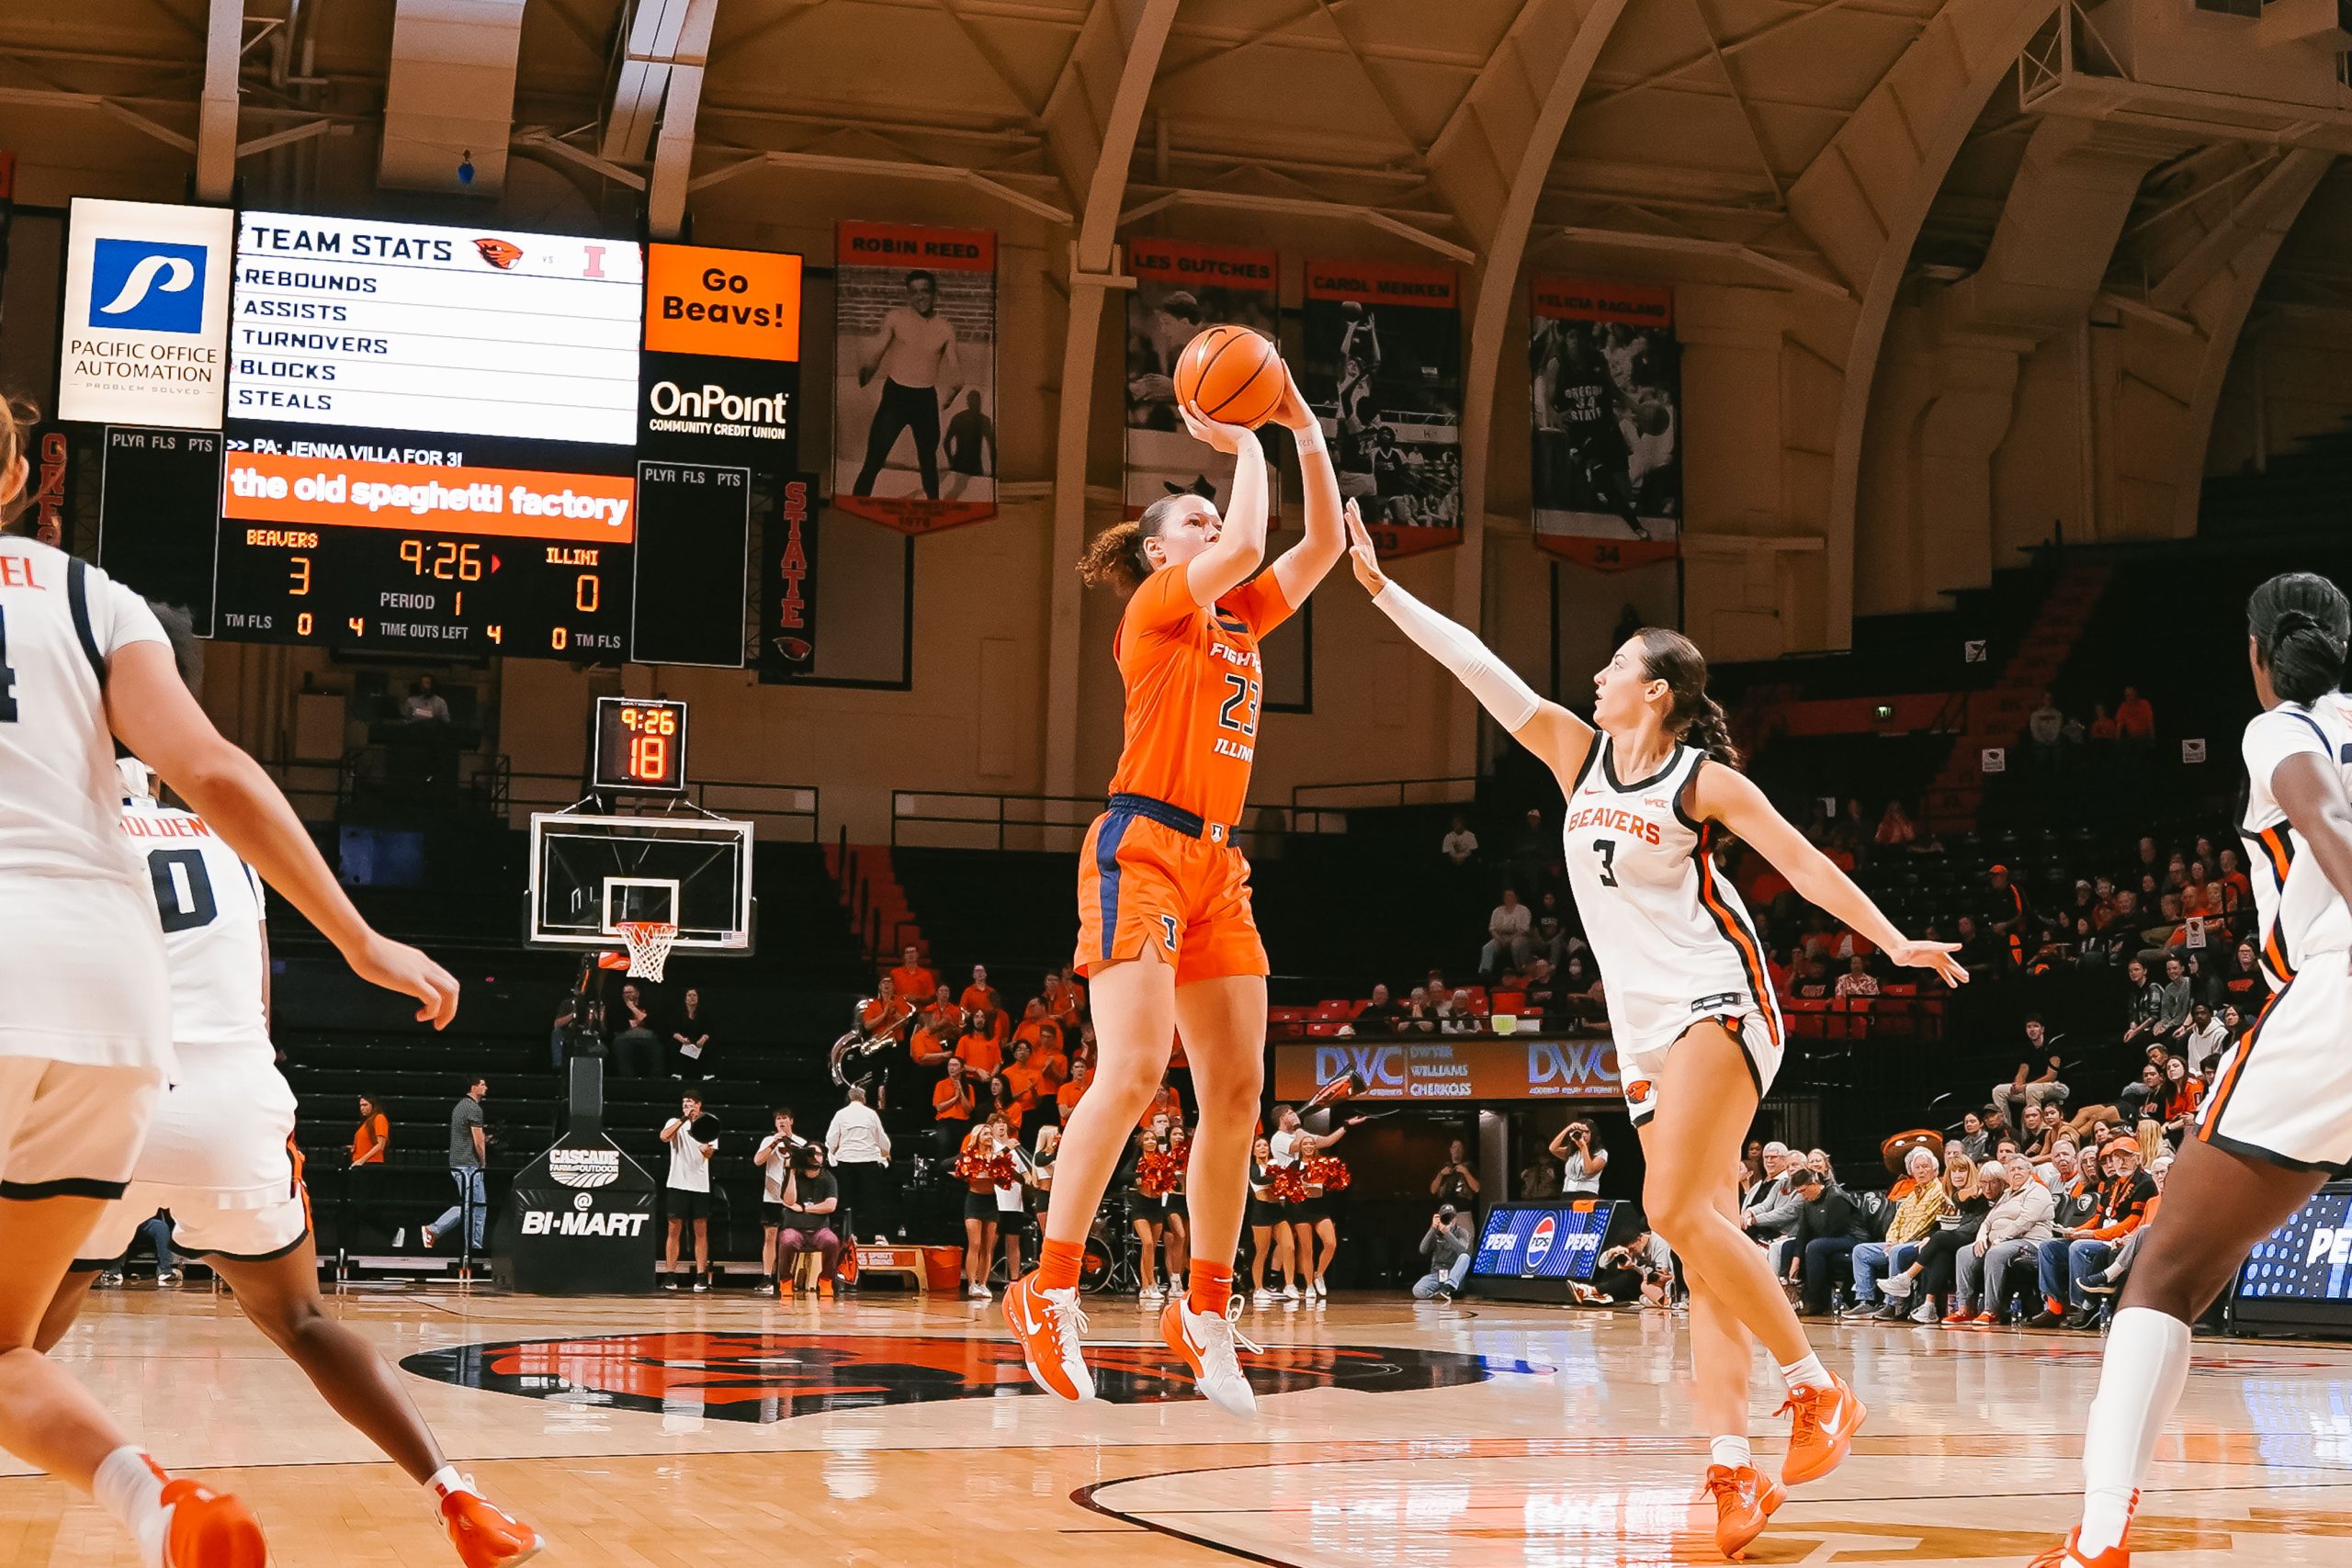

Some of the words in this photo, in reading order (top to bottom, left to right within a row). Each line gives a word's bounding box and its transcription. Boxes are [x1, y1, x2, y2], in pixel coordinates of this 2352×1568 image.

[252, 227, 341, 254] TEAM
[352, 234, 452, 261] STATS
[852, 235, 917, 255] ROBIN
[923, 240, 981, 259] REED
[1134, 253, 1171, 270] LES
[1177, 257, 1271, 279] GUTCHES
[244, 268, 378, 293] REBOUNDS
[702, 268, 749, 294] Go
[1314, 276, 1369, 294] CAROL
[1376, 281, 1451, 298] MENKEN
[243, 300, 347, 321] ASSISTS
[662, 295, 784, 329] Beavs!
[71, 340, 145, 359] PACIFIC
[151, 344, 219, 364] OFFICE
[243, 329, 389, 355] TURNOVERS
[74, 360, 212, 383] AUTOMATION
[240, 359, 336, 381] BLOCKS
[85, 382, 145, 391] PROBLEM
[152, 387, 201, 396] SOLVED
[239, 389, 333, 411] STEALS
[650, 381, 788, 424] OnPoint
[650, 419, 713, 436] COMMUNITY
[714, 423, 752, 438] CREDIT
[752, 426, 786, 440] UNION
[112, 434, 145, 447] PLYR
[152, 436, 175, 449] FLS
[188, 438, 213, 452] PTS
[254, 438, 282, 456] PA:
[287, 441, 348, 460] JENNA
[350, 446, 401, 464] VILLA
[402, 449, 443, 467] FOR
[645, 468, 675, 484] PLYR
[683, 469, 706, 485] FLS
[717, 472, 741, 488] PTS
[230, 467, 288, 499] the
[294, 472, 346, 504] old
[350, 479, 503, 515] spaghetti
[509, 486, 629, 525] factory
[246, 529, 319, 548] BEAVERS
[400, 539, 481, 581] 9:26
[546, 547, 599, 566] ILLINI
[781, 480, 808, 630] STATE
[1594, 545, 1622, 564] 34
[288, 557, 311, 595] 3
[380, 592, 435, 611] PERIOD
[455, 592, 462, 616] 1
[576, 574, 599, 613] 0
[225, 614, 246, 627] TM
[248, 615, 272, 630] FLS
[298, 612, 313, 637] 0
[348, 616, 364, 637] 4
[380, 622, 408, 637] TIME
[410, 624, 439, 640] OUTS
[442, 626, 469, 641] LEFT
[487, 625, 503, 645] 4
[552, 626, 567, 650] 0
[576, 634, 595, 647] TM
[598, 634, 621, 649] FLS
[1218, 672, 1261, 738] 23
[621, 708, 675, 736] 9:26
[629, 737, 664, 779] 18
[1567, 807, 1661, 846] BEAVERS
[1592, 839, 1619, 888] 3
[147, 849, 218, 933] 0
[1316, 1045, 1404, 1087] DWC
[1529, 1043, 1622, 1085] DWC
[549, 1149, 620, 1166] CASCADE
[580, 1165, 619, 1174] OUTDOOR
[574, 1192, 594, 1212] @
[1485, 1233, 1519, 1250] PEPSI
[1530, 1236, 1552, 1247] PEPSI
[1565, 1233, 1600, 1250] PEPSI
[2306, 1227, 2352, 1265] PE
